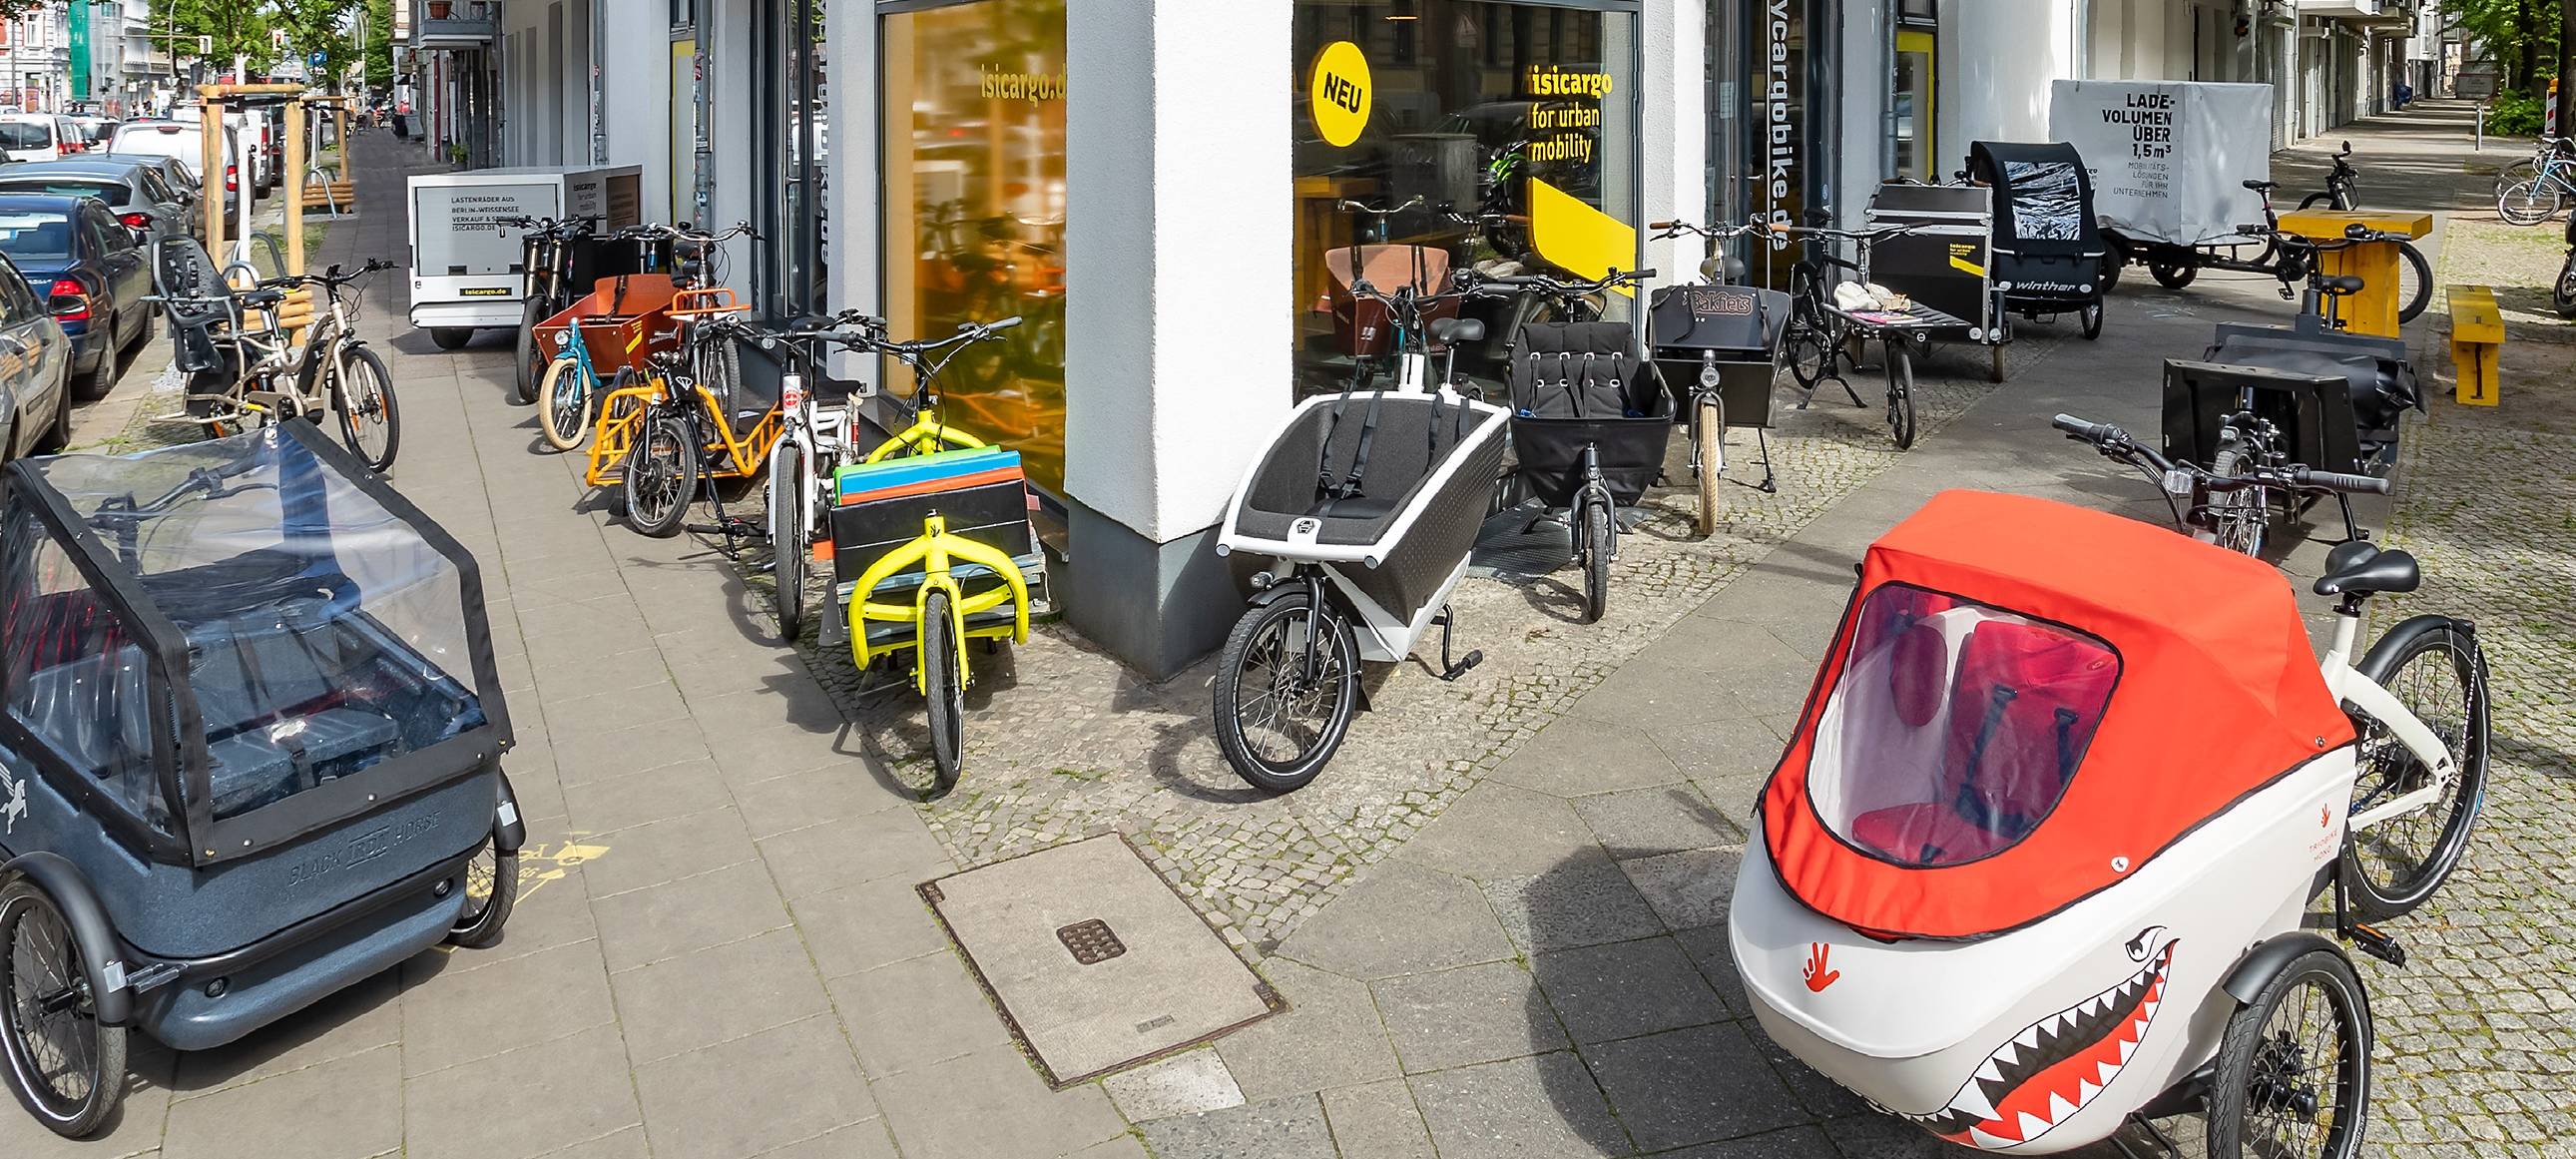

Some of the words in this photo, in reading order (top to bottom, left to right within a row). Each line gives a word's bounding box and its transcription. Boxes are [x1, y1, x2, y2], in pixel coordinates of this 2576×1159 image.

[1532, 64, 1613, 99] isicargo
[1323, 71, 1362, 113] NEU
[2127, 93, 2176, 109] LADE-
[1532, 102, 1556, 129] for
[1558, 101, 1600, 128] urban
[2102, 109, 2173, 126] VOLUMEN
[2133, 124, 2171, 143] ÜBER
[1532, 132, 1593, 164] mobility
[2113, 188, 2169, 199] UNTERNEHMEN
[464, 288, 507, 296] isicargo.de
[2016, 281, 2076, 291] winther
[288, 850, 341, 886] BLACK
[394, 811, 440, 846] HORSE
